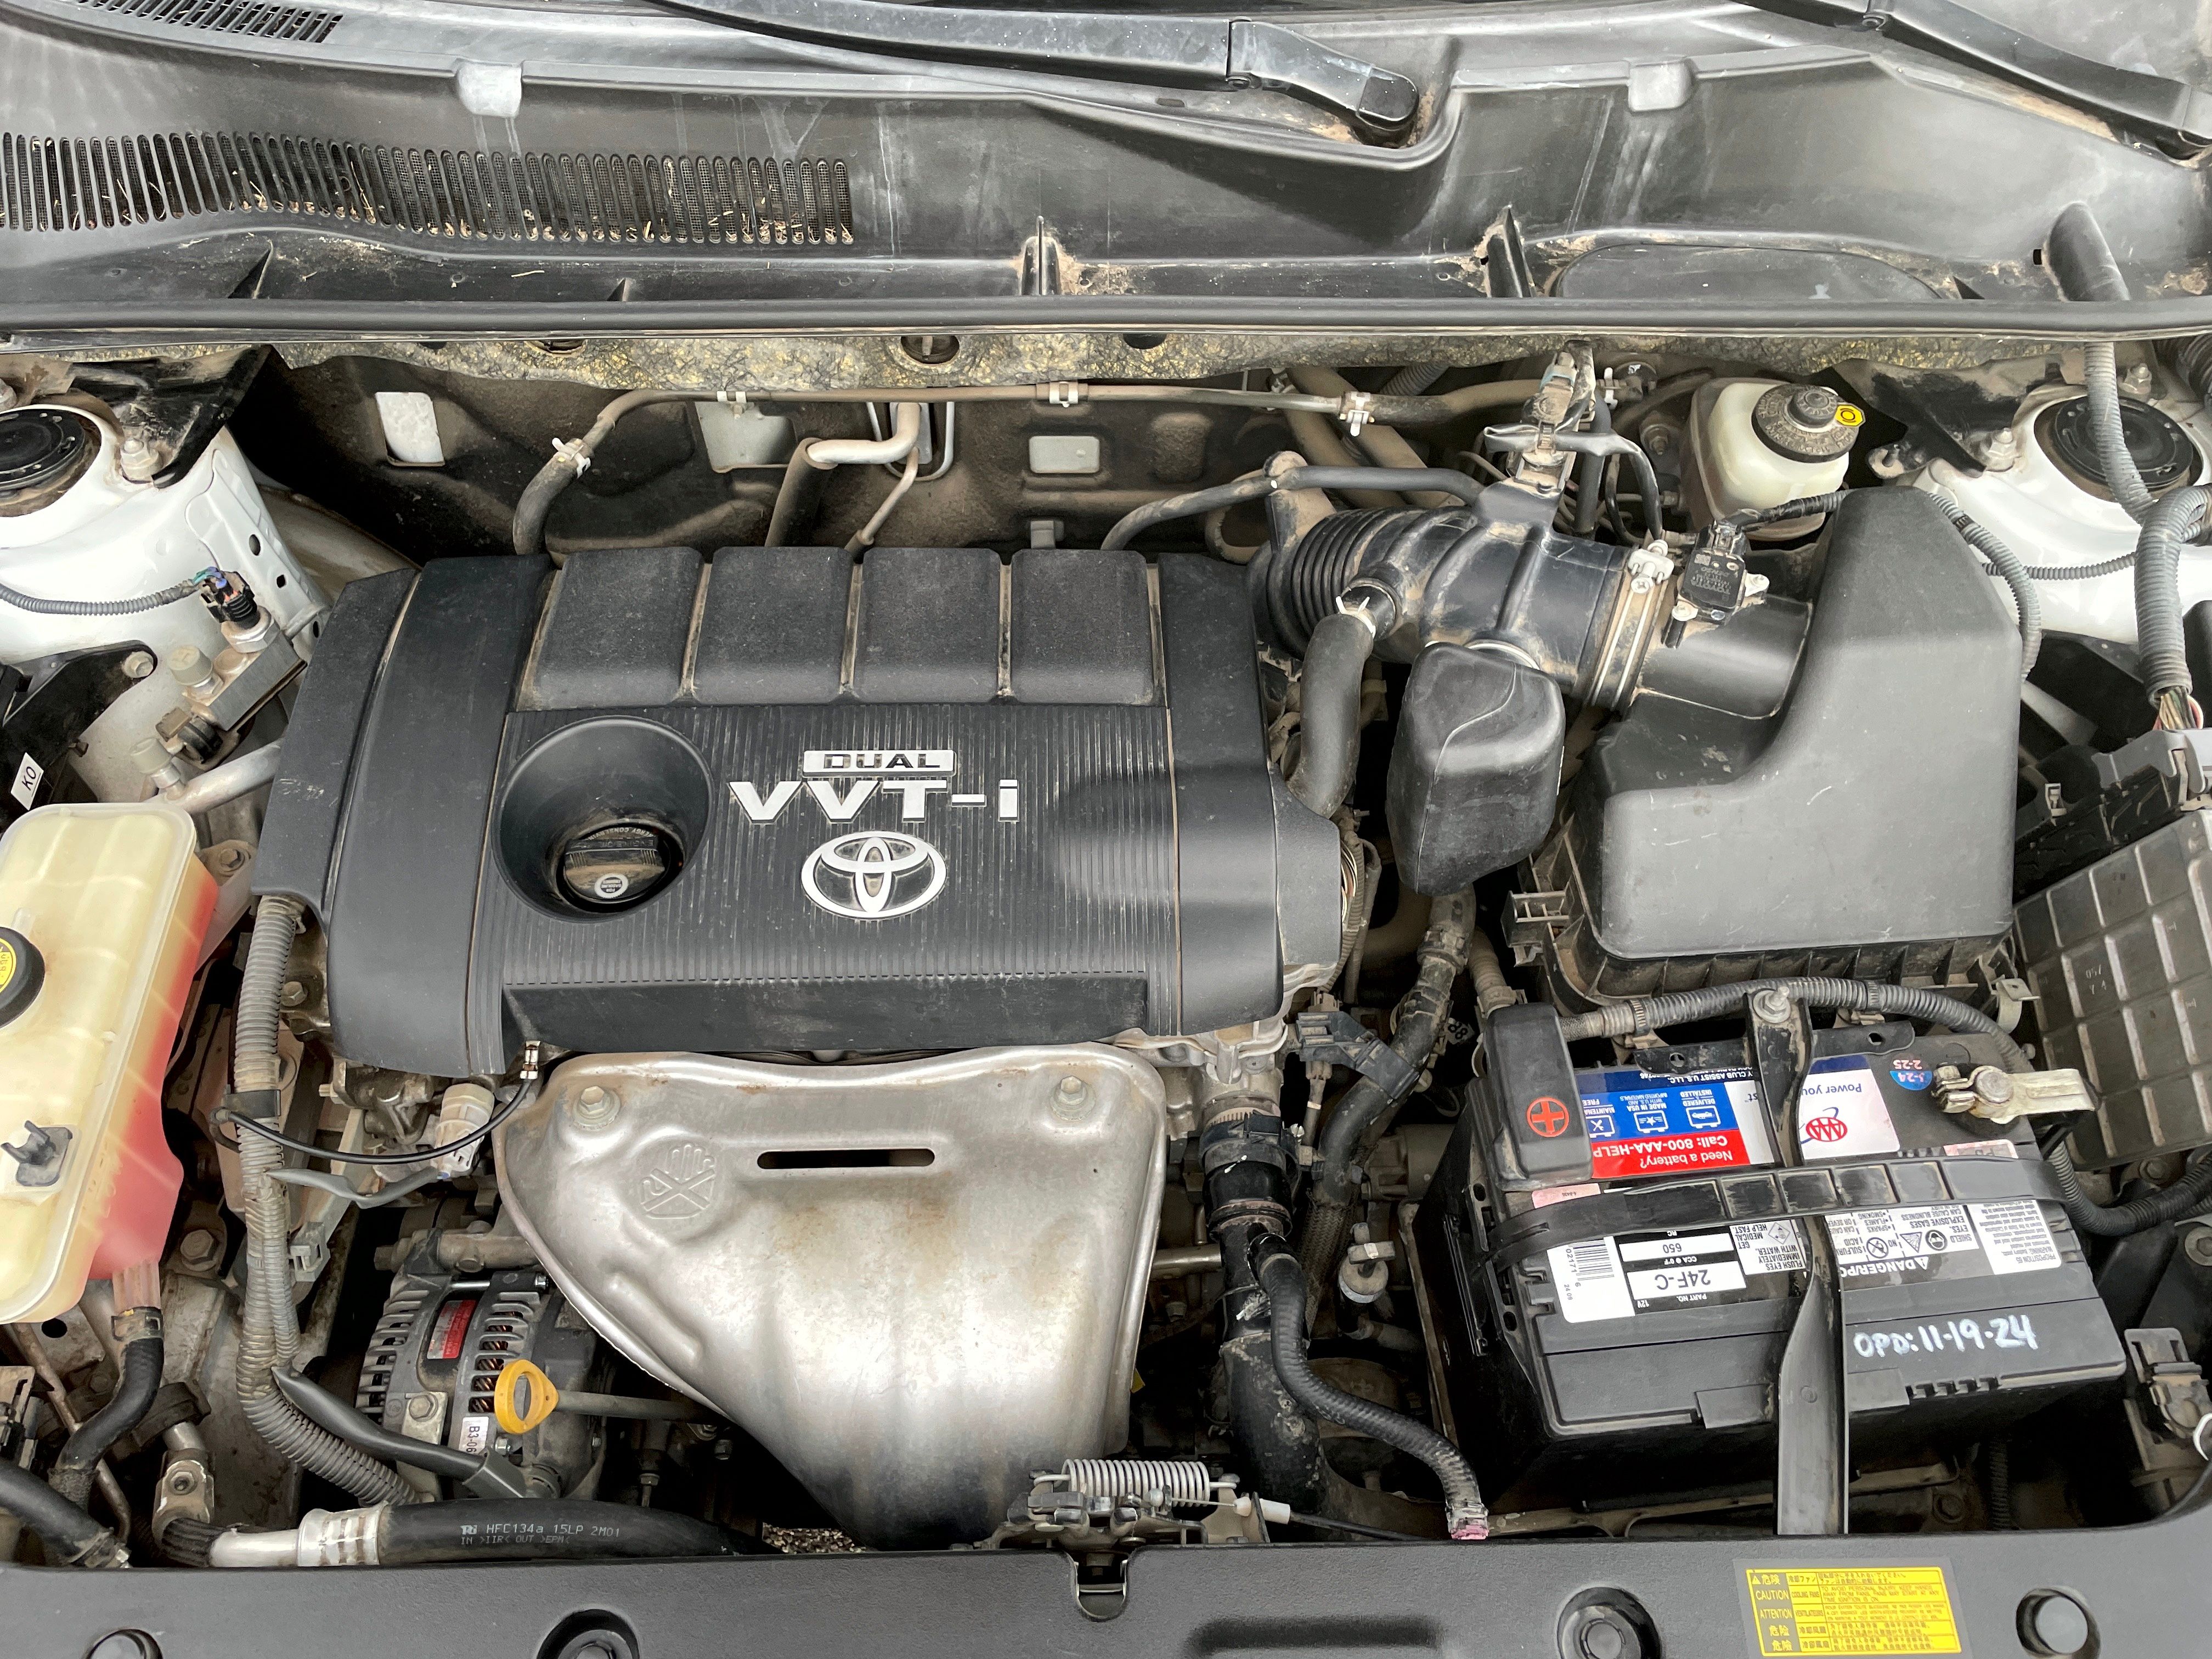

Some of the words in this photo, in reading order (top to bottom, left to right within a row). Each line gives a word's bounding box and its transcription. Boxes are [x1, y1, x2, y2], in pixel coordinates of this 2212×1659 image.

[824, 753, 940, 768] DUAL
[729, 779, 1018, 822] VVT-i
[1893, 1059, 1922, 1070] 2-25
[1826, 1083, 1862, 1094] Power
[1680, 1089, 1712, 1098] INSTALLED
[1683, 1098, 1716, 1107] DELIVERED
[1808, 1118, 1845, 1141] AAA
[1696, 1135, 1728, 1148] Call:
[1593, 1138, 1694, 1158] 800-AAA-HELP
[1690, 1154, 1697, 1162] a
[1701, 1150, 1733, 1163] Need
[1640, 1154, 1688, 1169] battery?
[1901, 1212, 1930, 1220] BLINDNESS
[1909, 1220, 1930, 1228] GASES
[1931, 1216, 1965, 1227] EXPLOSIVE
[1752, 1223, 1767, 1232] HELP
[1949, 1224, 1968, 1233] EYES.
[1734, 1232, 1763, 1241] MEDICAL
[1950, 1234, 1972, 1243] SHIELD
[1738, 1241, 1750, 1249] GET
[1843, 1238, 1859, 1246] ACID
[1662, 1243, 1682, 1254] 650
[1756, 1247, 1779, 1255] WATER.
[1780, 1244, 1798, 1253] WITH
[1758, 1252, 1801, 1263] IMMEDIATELY
[2023, 1254, 2056, 1262] PROPOSITION
[1765, 1262, 1781, 1271] EYES
[1783, 1260, 1803, 1269] FLUSH
[1655, 1269, 1711, 1290] 24F-C
[1637, 1300, 1649, 1308] 12V
[466, 1426, 479, 1454] B3-06
[487, 1524, 544, 1534] HFC134a
[554, 1524, 583, 1534] 15LP
[591, 1527, 619, 1537] 2M01
[1756, 1590, 1790, 1600] CAUTION
[1760, 1609, 1793, 1619] ATTENTION
